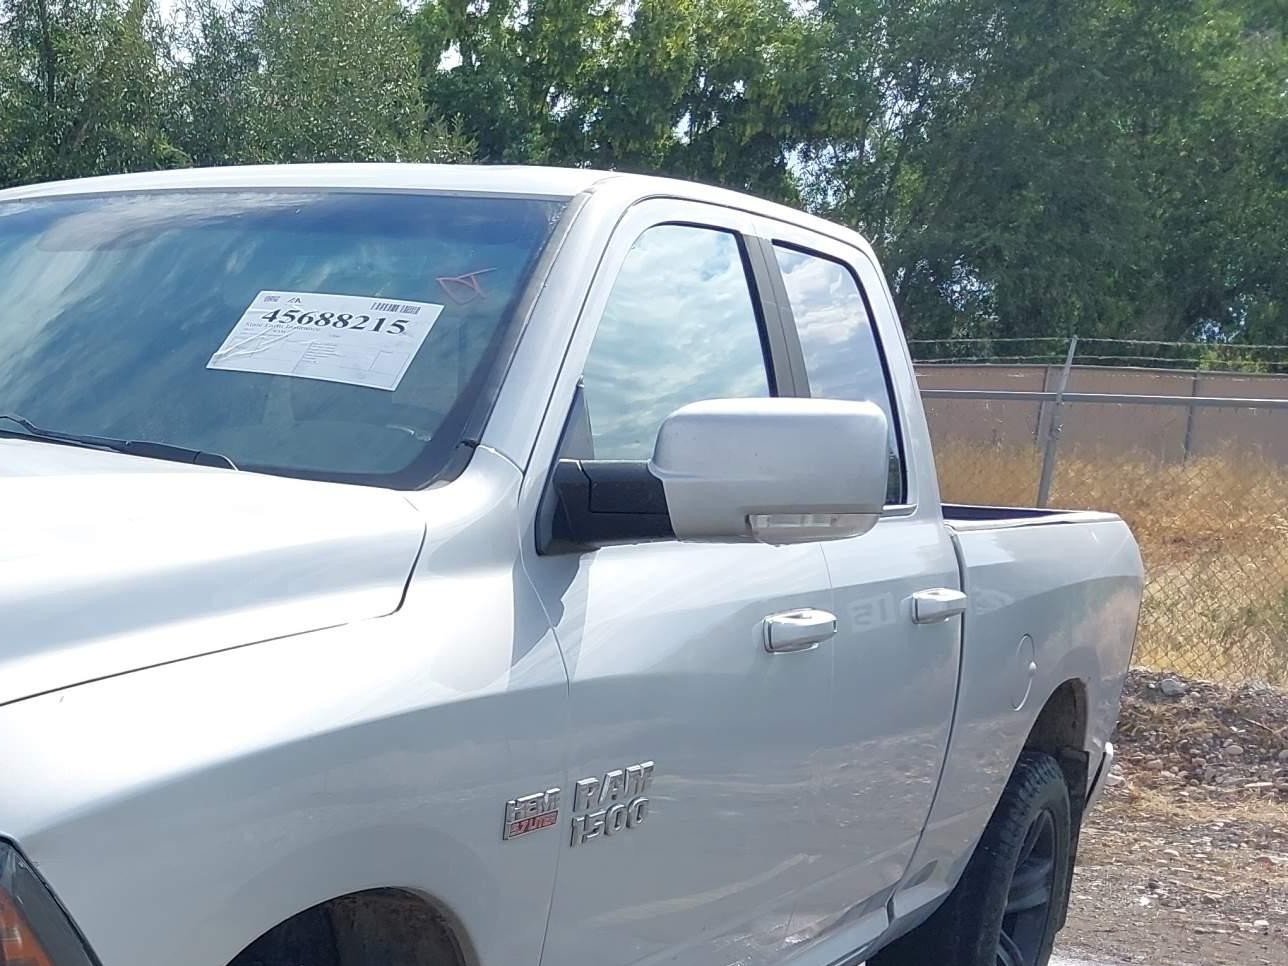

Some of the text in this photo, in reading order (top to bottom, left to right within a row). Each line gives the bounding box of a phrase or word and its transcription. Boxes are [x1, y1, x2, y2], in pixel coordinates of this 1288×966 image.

[261, 308, 411, 335] 45688215
[572, 760, 656, 812] RAM
[569, 796, 649, 848] 1500
